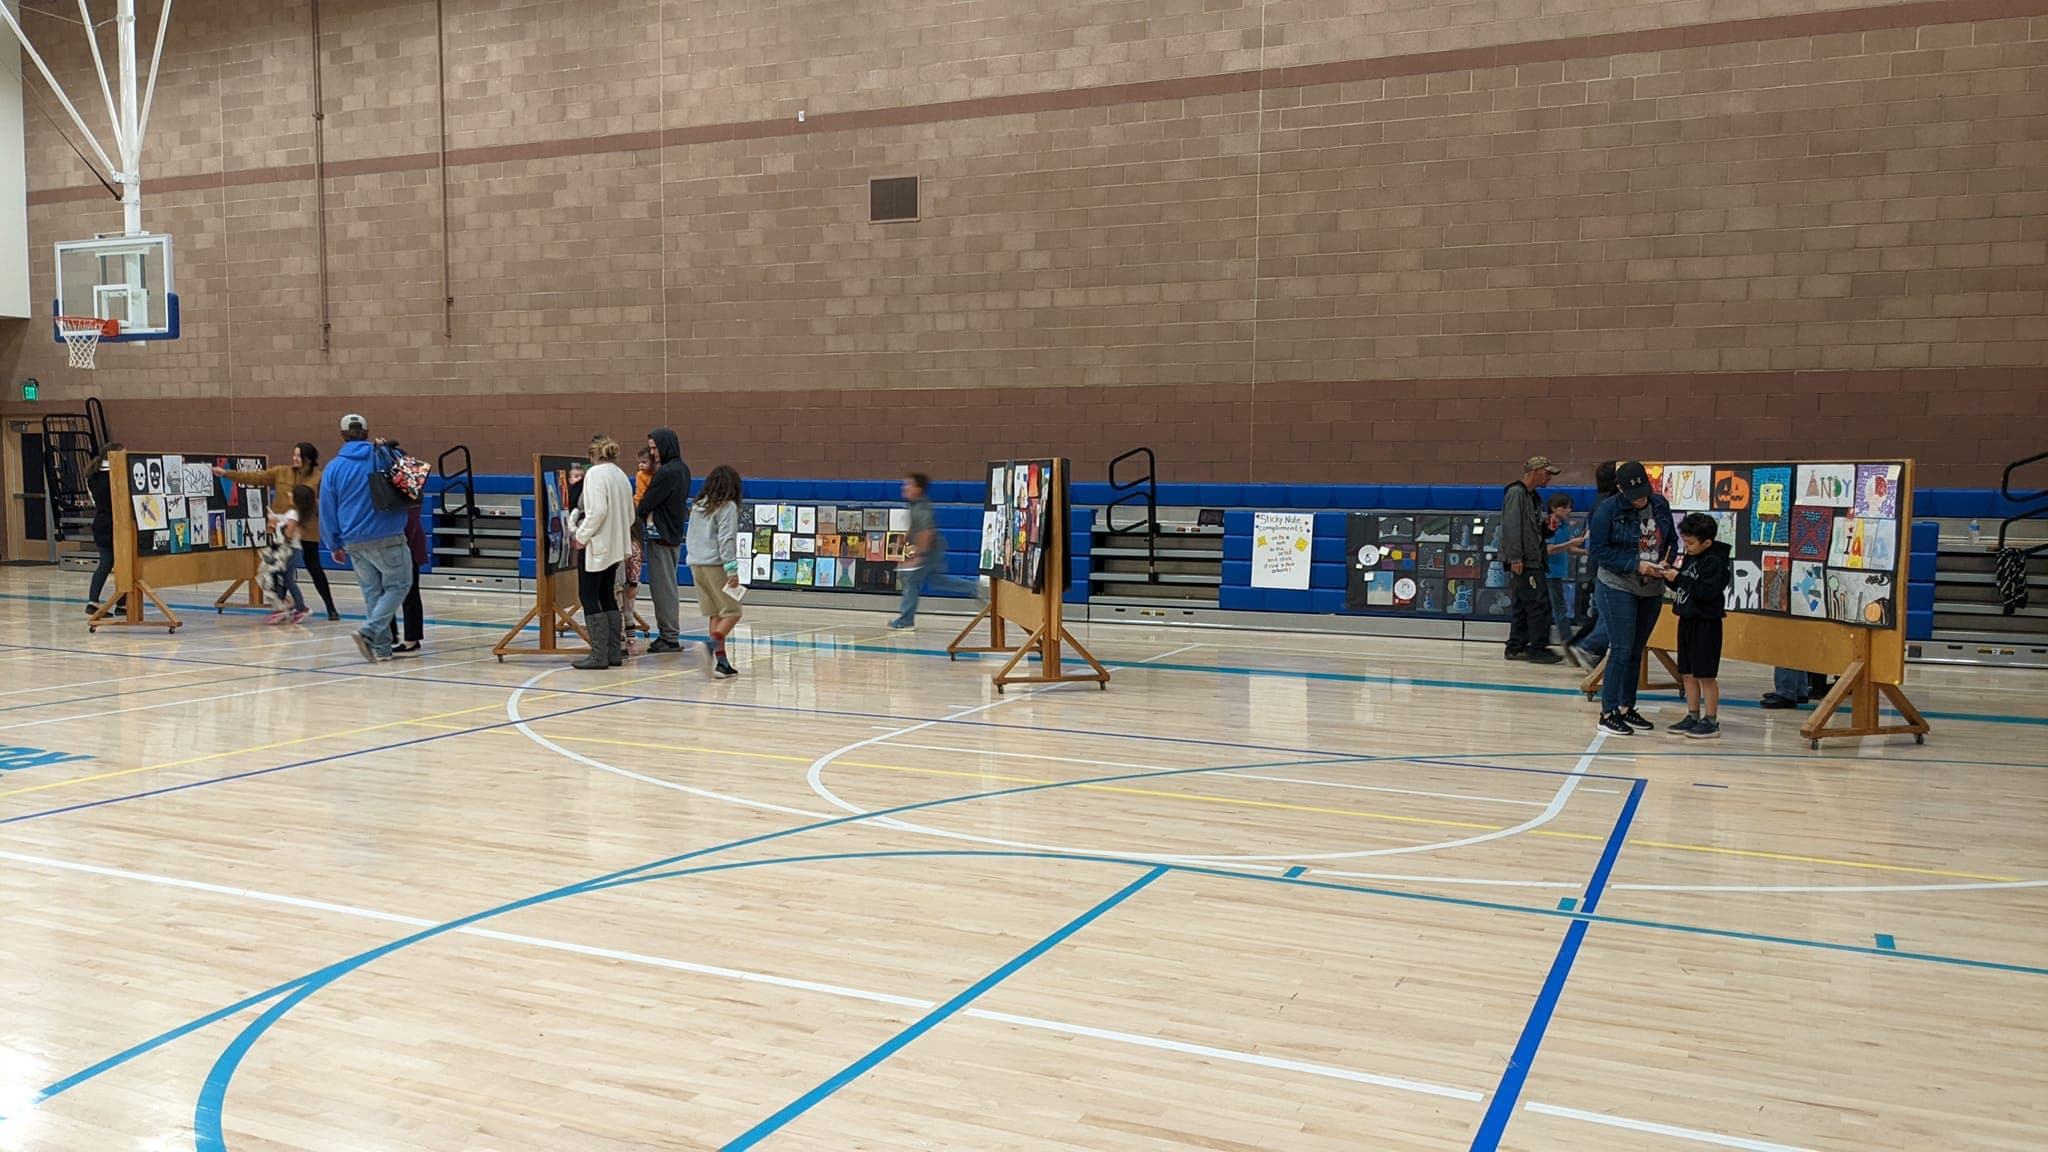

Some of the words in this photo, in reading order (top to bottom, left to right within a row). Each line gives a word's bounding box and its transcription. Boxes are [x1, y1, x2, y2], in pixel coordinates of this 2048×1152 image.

[24, 386, 36, 400] EXIT
[1806, 470, 1852, 499] ANDY
[1261, 514, 1284, 525] Sticky
[1285, 516, 1302, 525] Note
